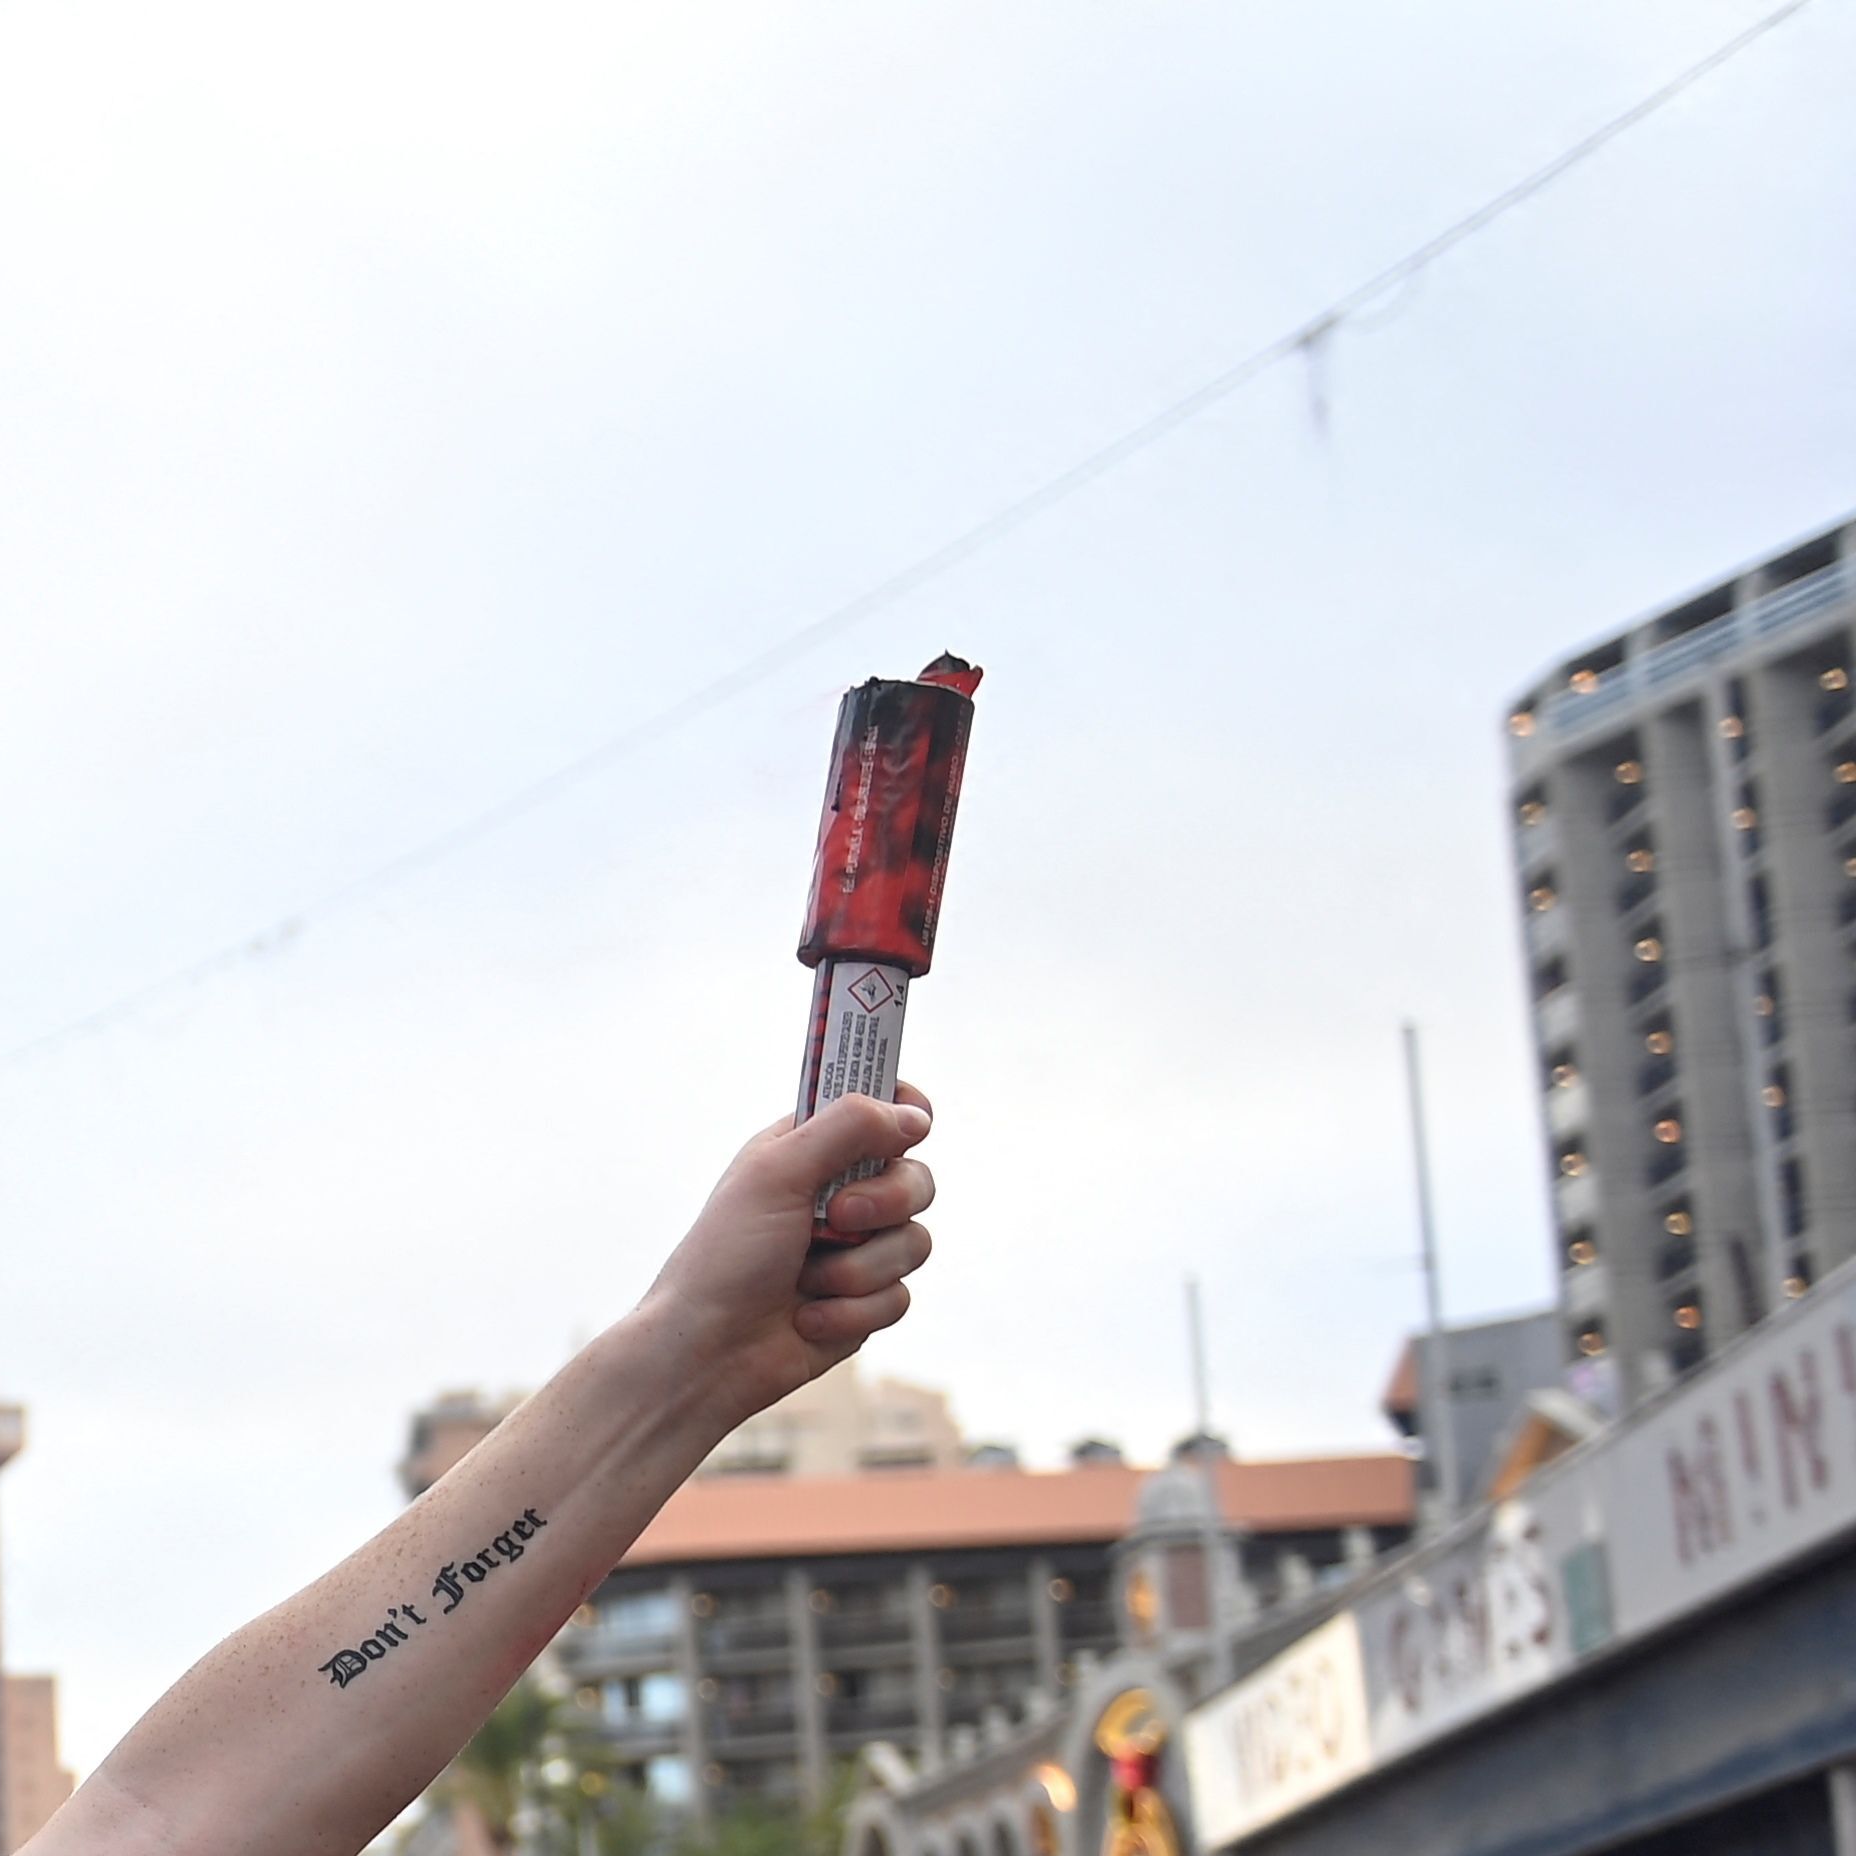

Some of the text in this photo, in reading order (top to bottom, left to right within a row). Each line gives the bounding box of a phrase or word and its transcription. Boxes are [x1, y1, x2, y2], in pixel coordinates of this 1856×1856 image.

[946, 756, 960, 794] HUMO
[942, 796, 953, 814] DE
[893, 984, 906, 1009] 1.4
[318, 1603, 427, 1689] Don't
